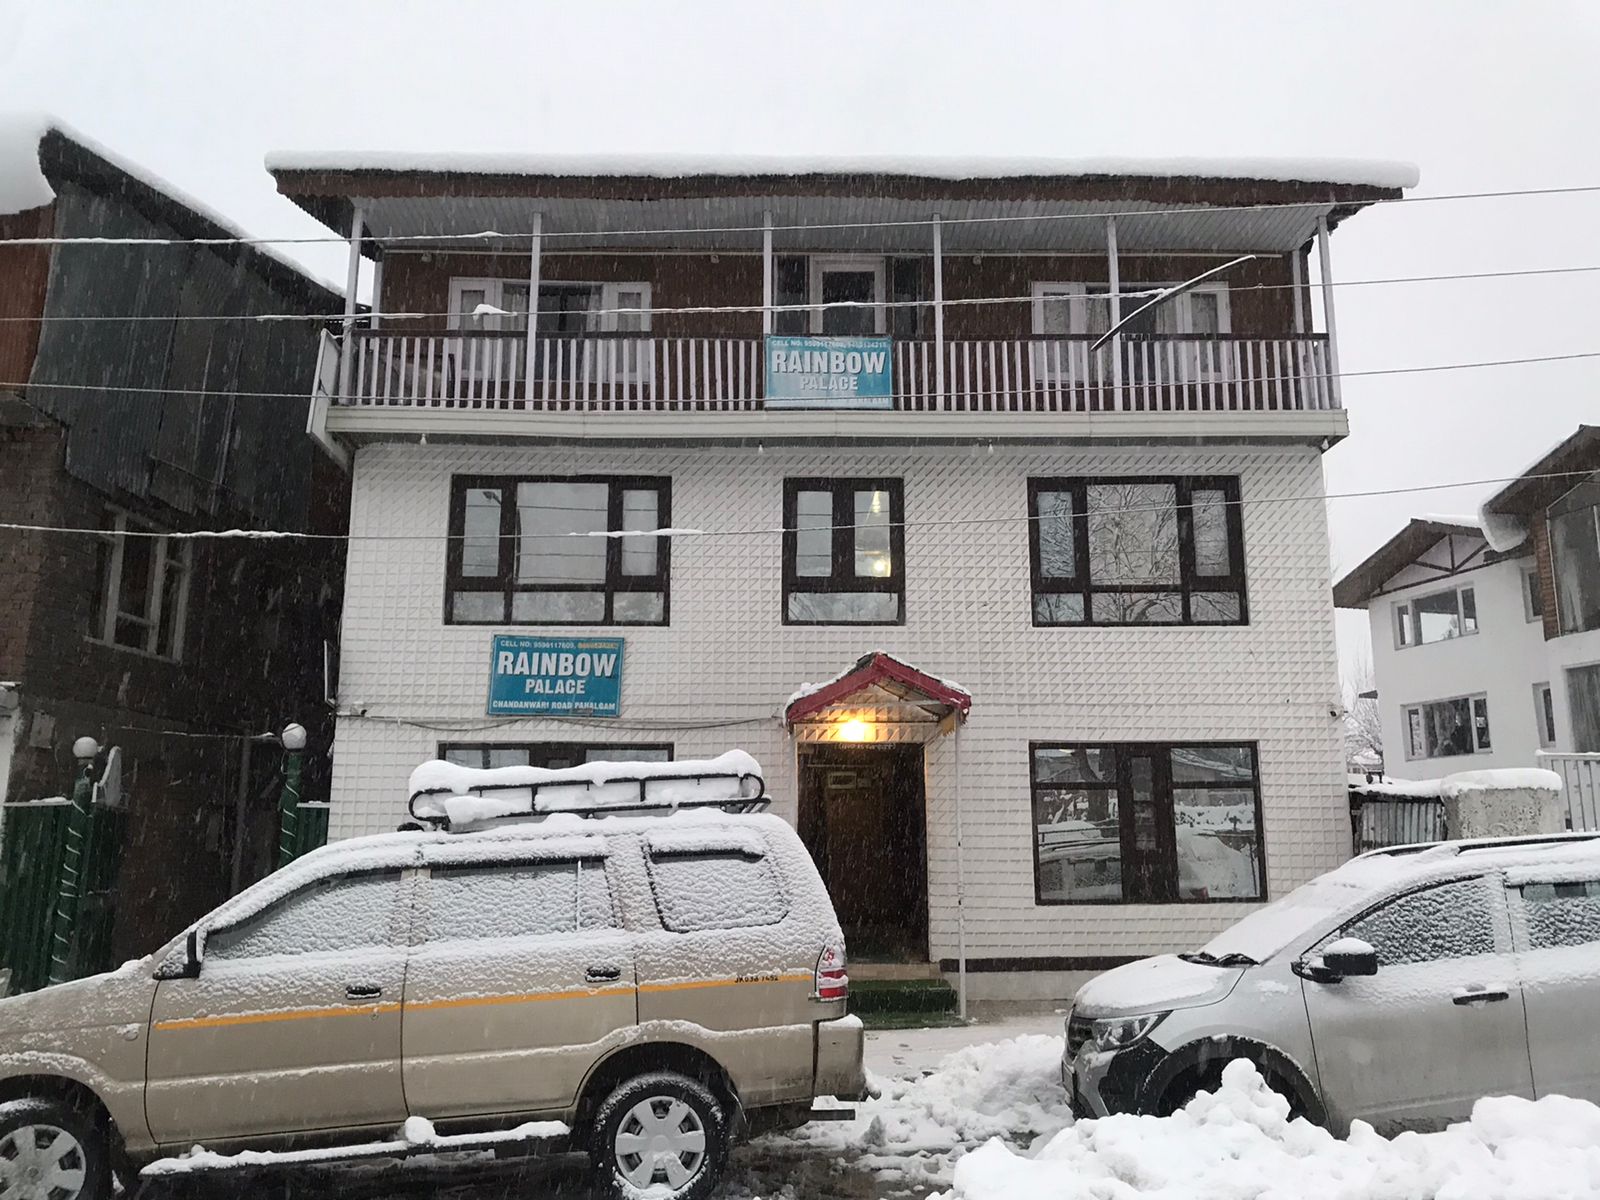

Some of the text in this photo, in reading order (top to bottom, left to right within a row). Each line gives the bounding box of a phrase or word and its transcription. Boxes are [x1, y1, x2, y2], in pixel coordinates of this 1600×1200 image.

[772, 350, 886, 374] RAINBOW
[801, 376, 858, 391] PALACE
[500, 640, 518, 648] CELL
[497, 651, 617, 677] RAINBOW
[525, 679, 586, 694] PALACE
[492, 700, 616, 710] CHANDANWARI ROAD PAHALGAM
